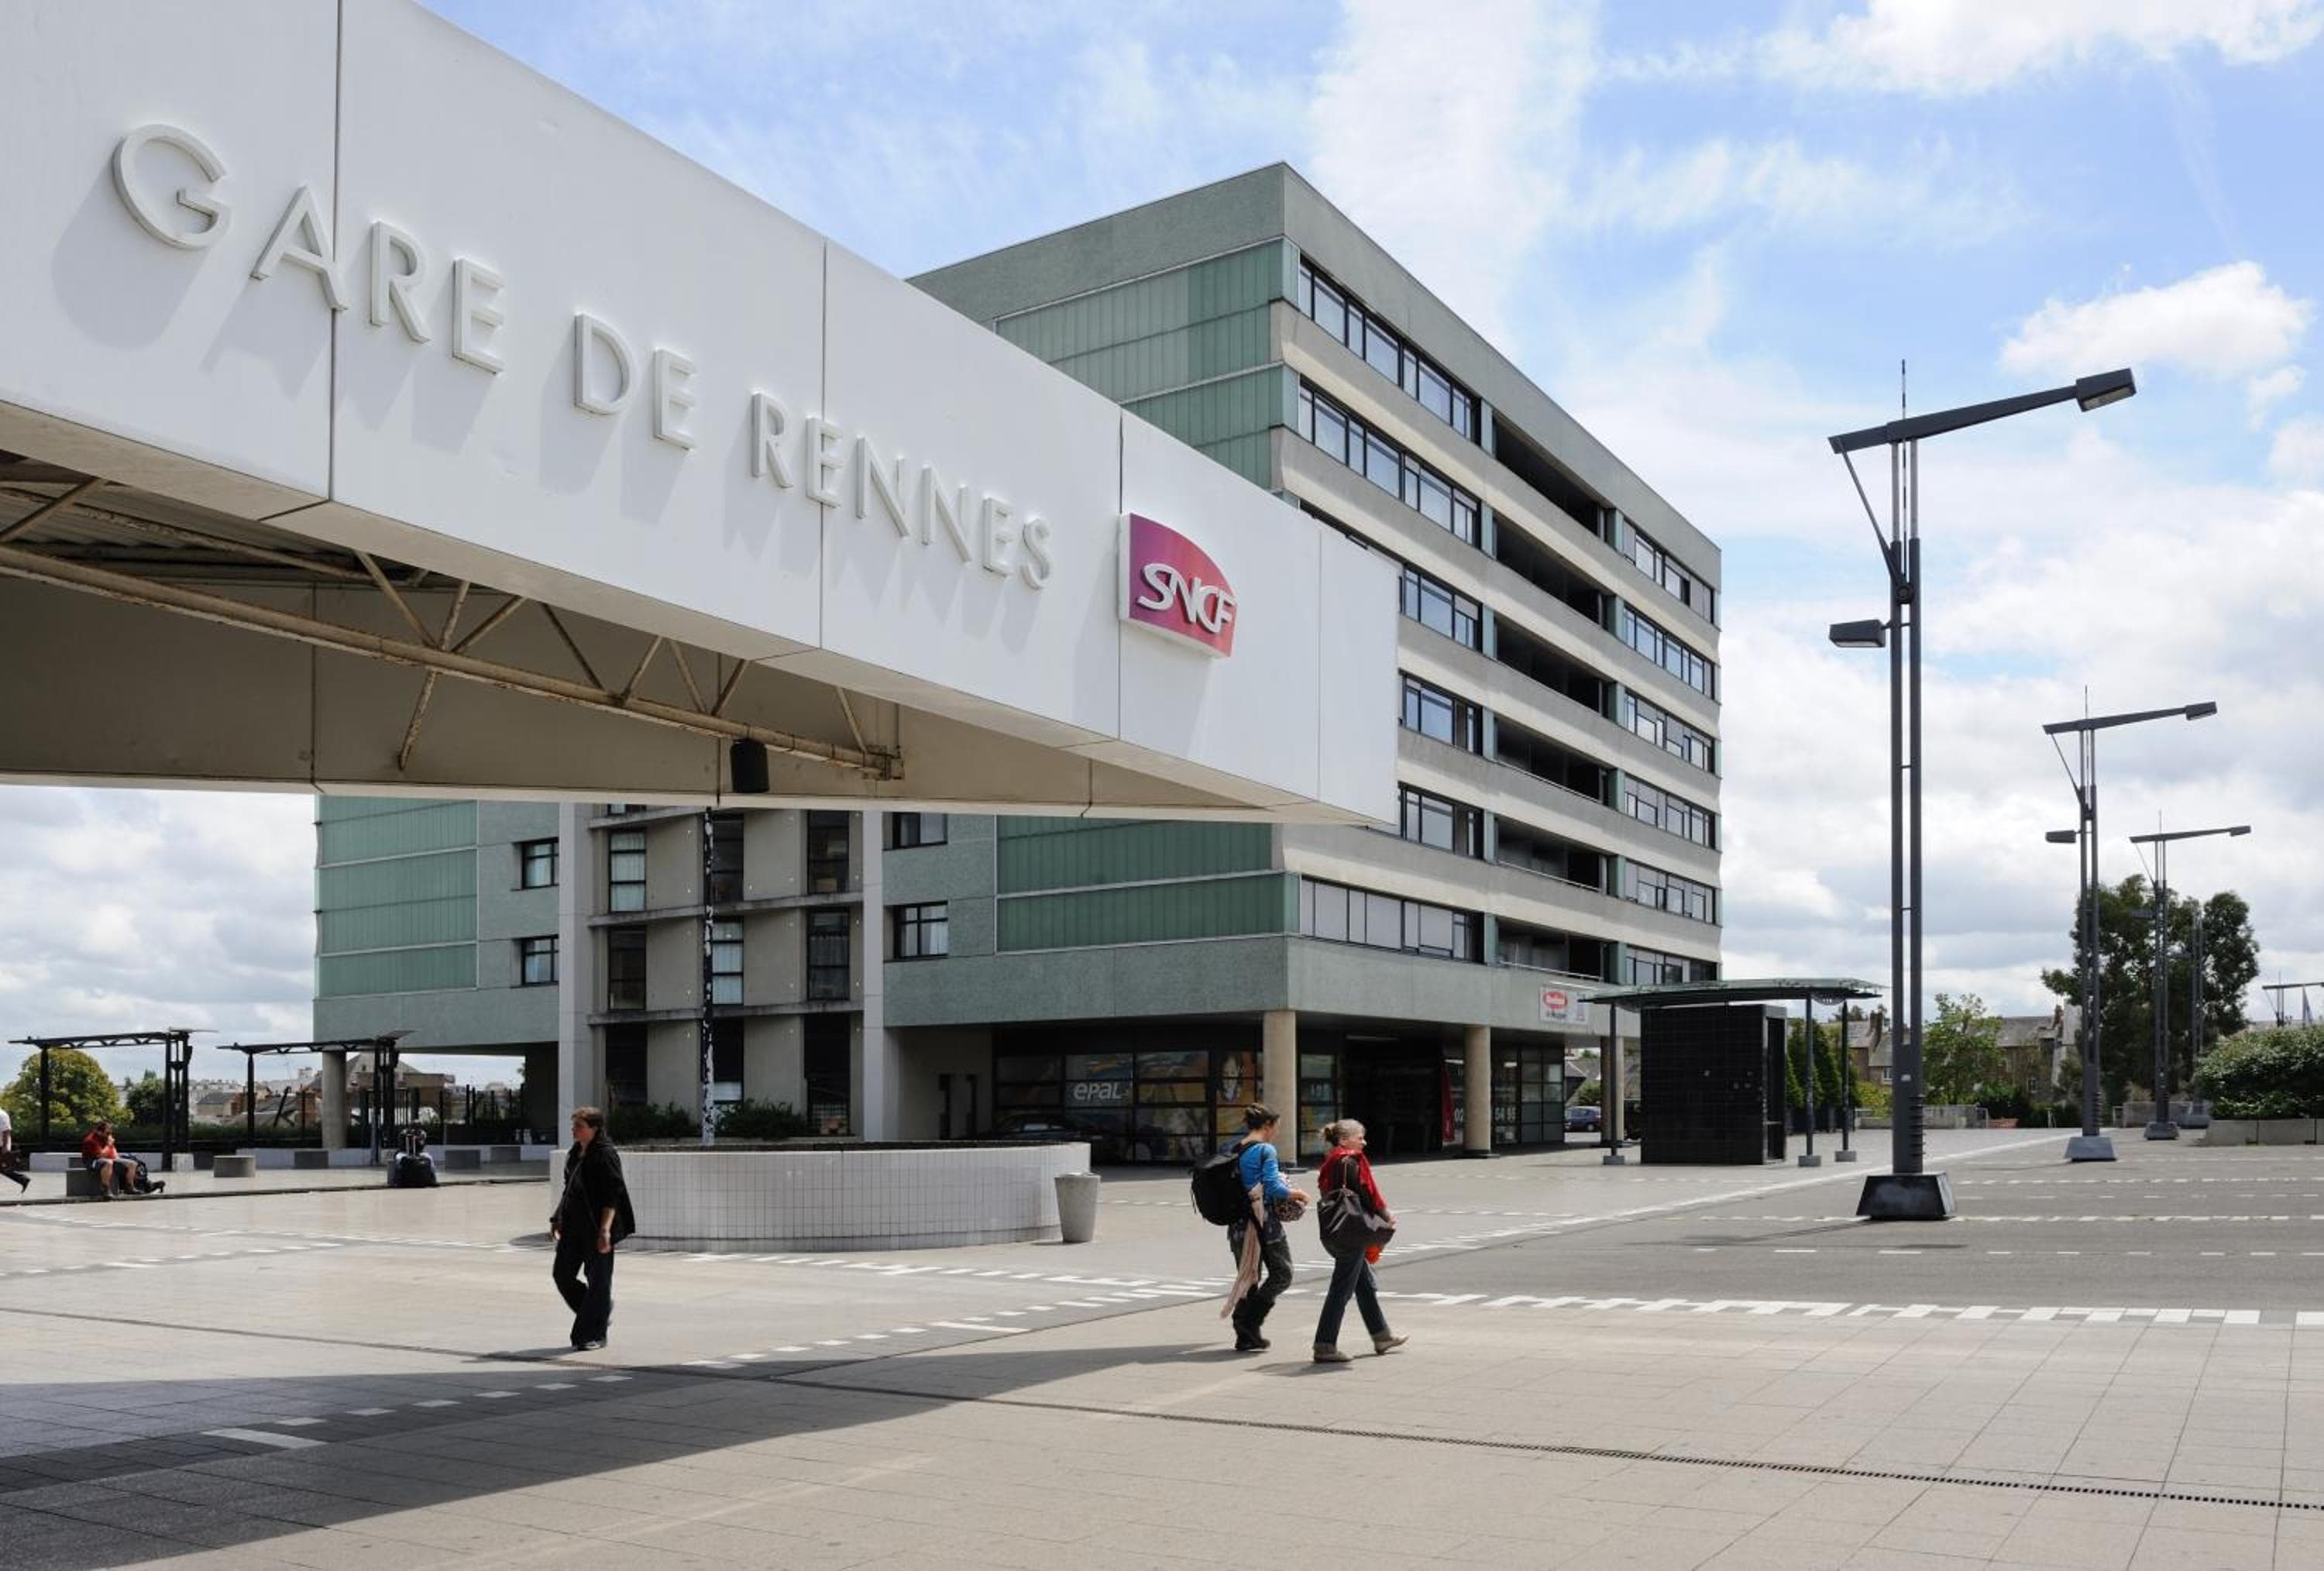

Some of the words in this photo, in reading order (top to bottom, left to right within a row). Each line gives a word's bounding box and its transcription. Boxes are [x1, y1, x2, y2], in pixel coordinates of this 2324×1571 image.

[112, 123, 506, 376] GARE
[574, 311, 695, 450] DE
[751, 391, 1054, 591] RENNES
[1137, 563, 1238, 634] SNCF
